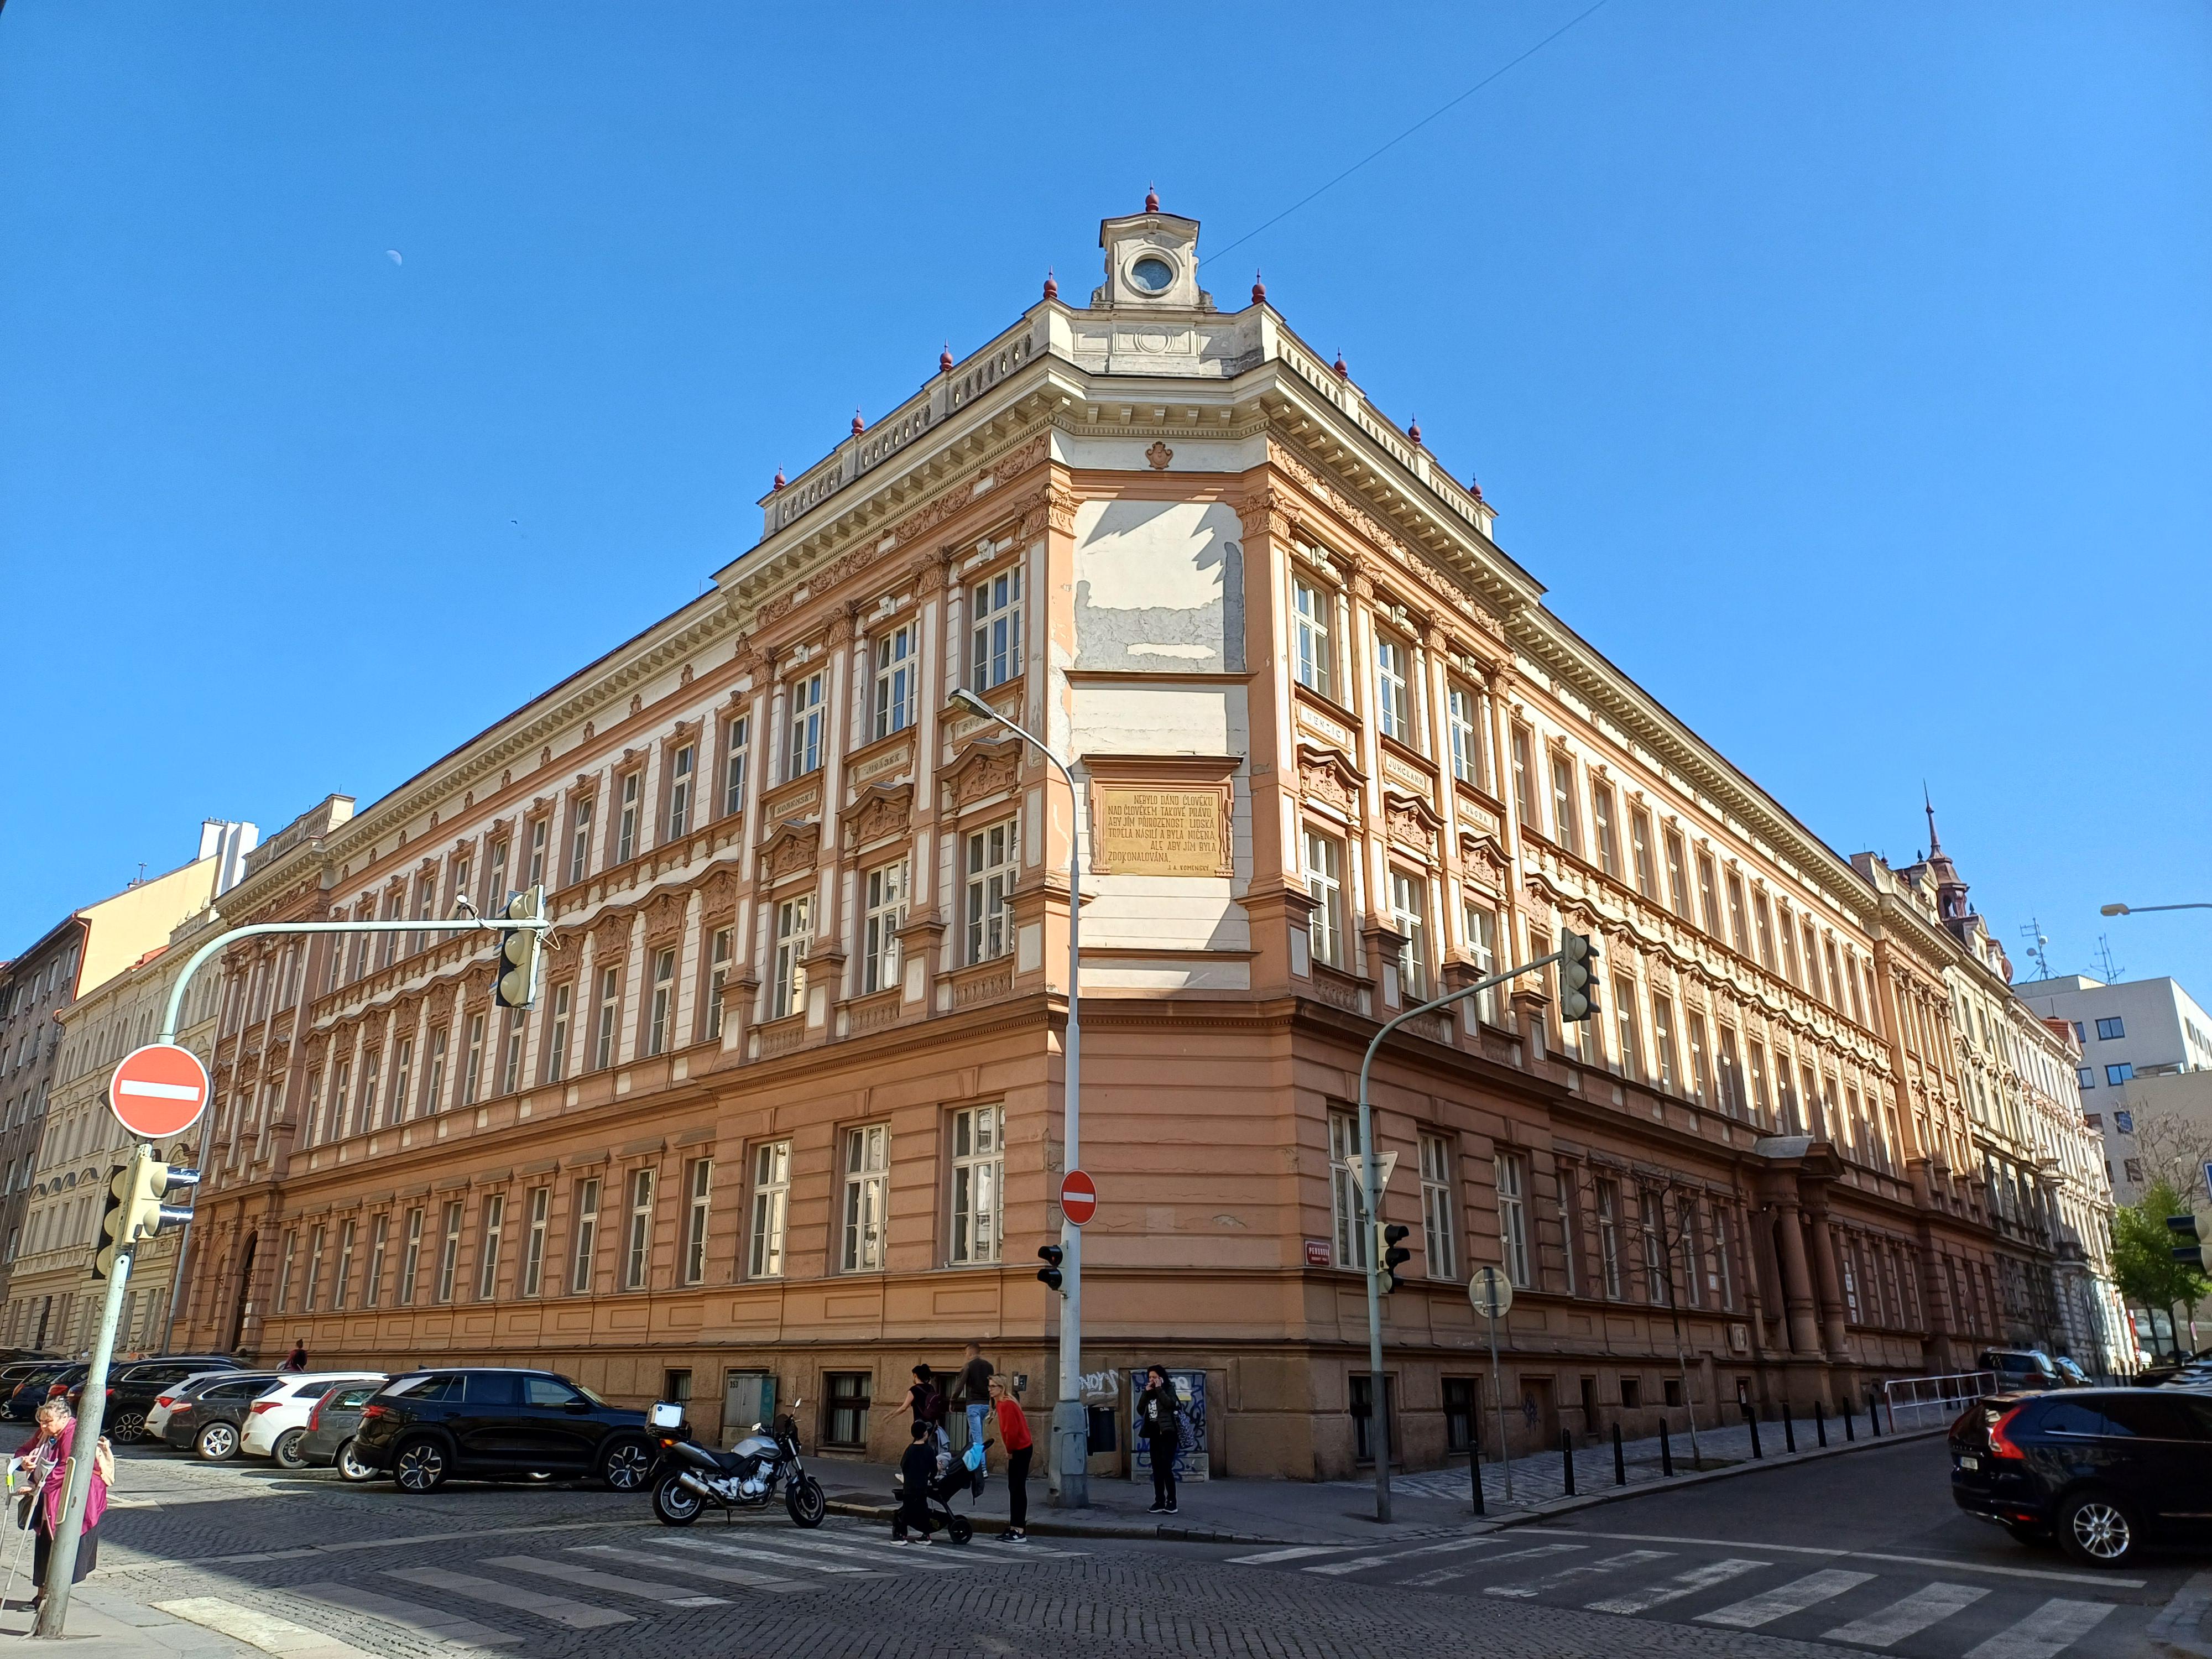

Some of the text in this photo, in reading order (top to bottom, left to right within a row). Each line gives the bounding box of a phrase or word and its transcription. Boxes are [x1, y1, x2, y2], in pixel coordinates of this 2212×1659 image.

[1134, 794, 1213, 806] NEBYLO DÁNO ČLOVĚKU
[1108, 806, 1122, 815] NAD
[1124, 805, 1157, 816] ČLOVĚKEM
[1160, 806, 1186, 817] TAKOVÉ
[1108, 816, 1214, 828] ABY JÍM PŘIROZENOST LIDSKÁ
[1108, 828, 1217, 841] TRPĚLA NÁSILÍ A BYLA NIČENA,
[1150, 840, 1217, 852] ALE ABY JÍM BYLA
[1108, 852, 1171, 863] ZDOKONALOVÁNA.
[729, 1380, 738, 1389] 353
